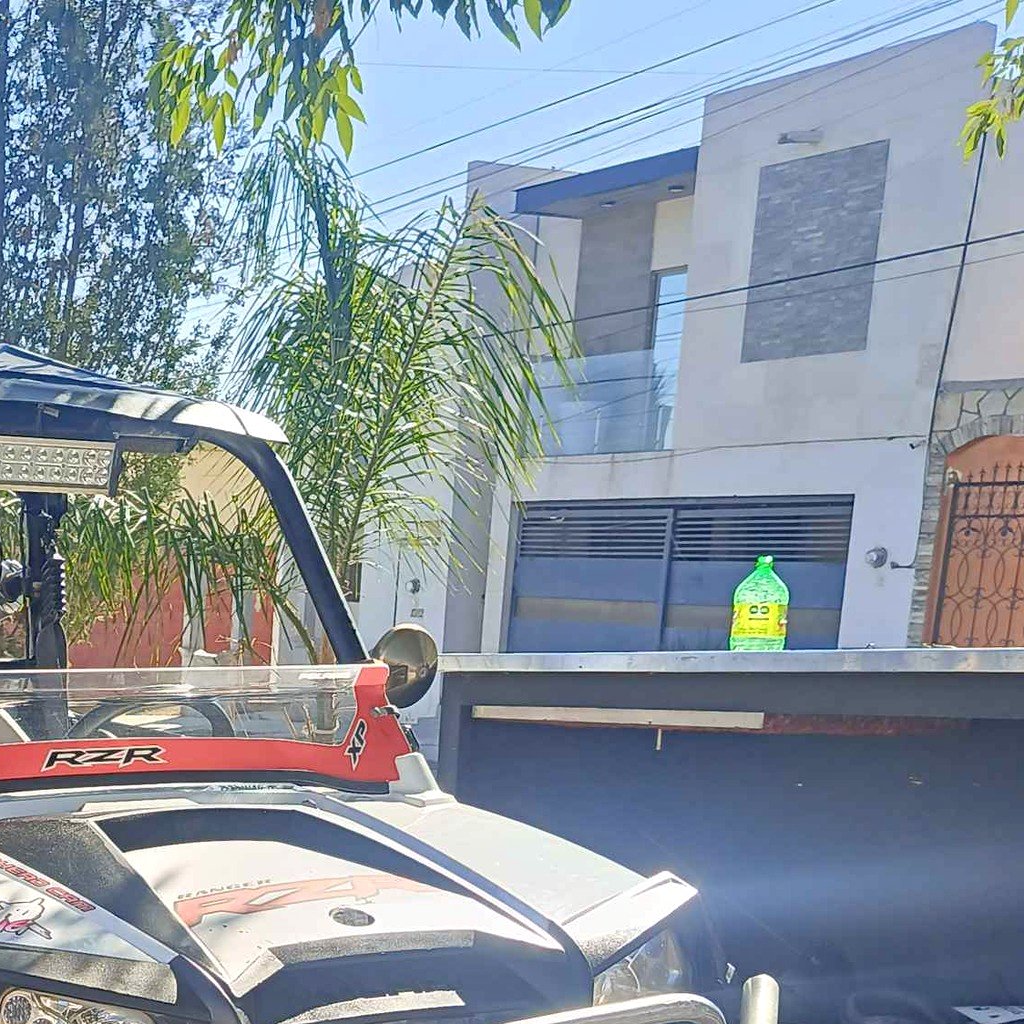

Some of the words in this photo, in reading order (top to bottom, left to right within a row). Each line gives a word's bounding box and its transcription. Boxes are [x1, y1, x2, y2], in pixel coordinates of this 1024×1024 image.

[42, 746, 167, 771] RZR
[46, 886, 96, 912] CAM
[177, 878, 272, 899] RANGER
